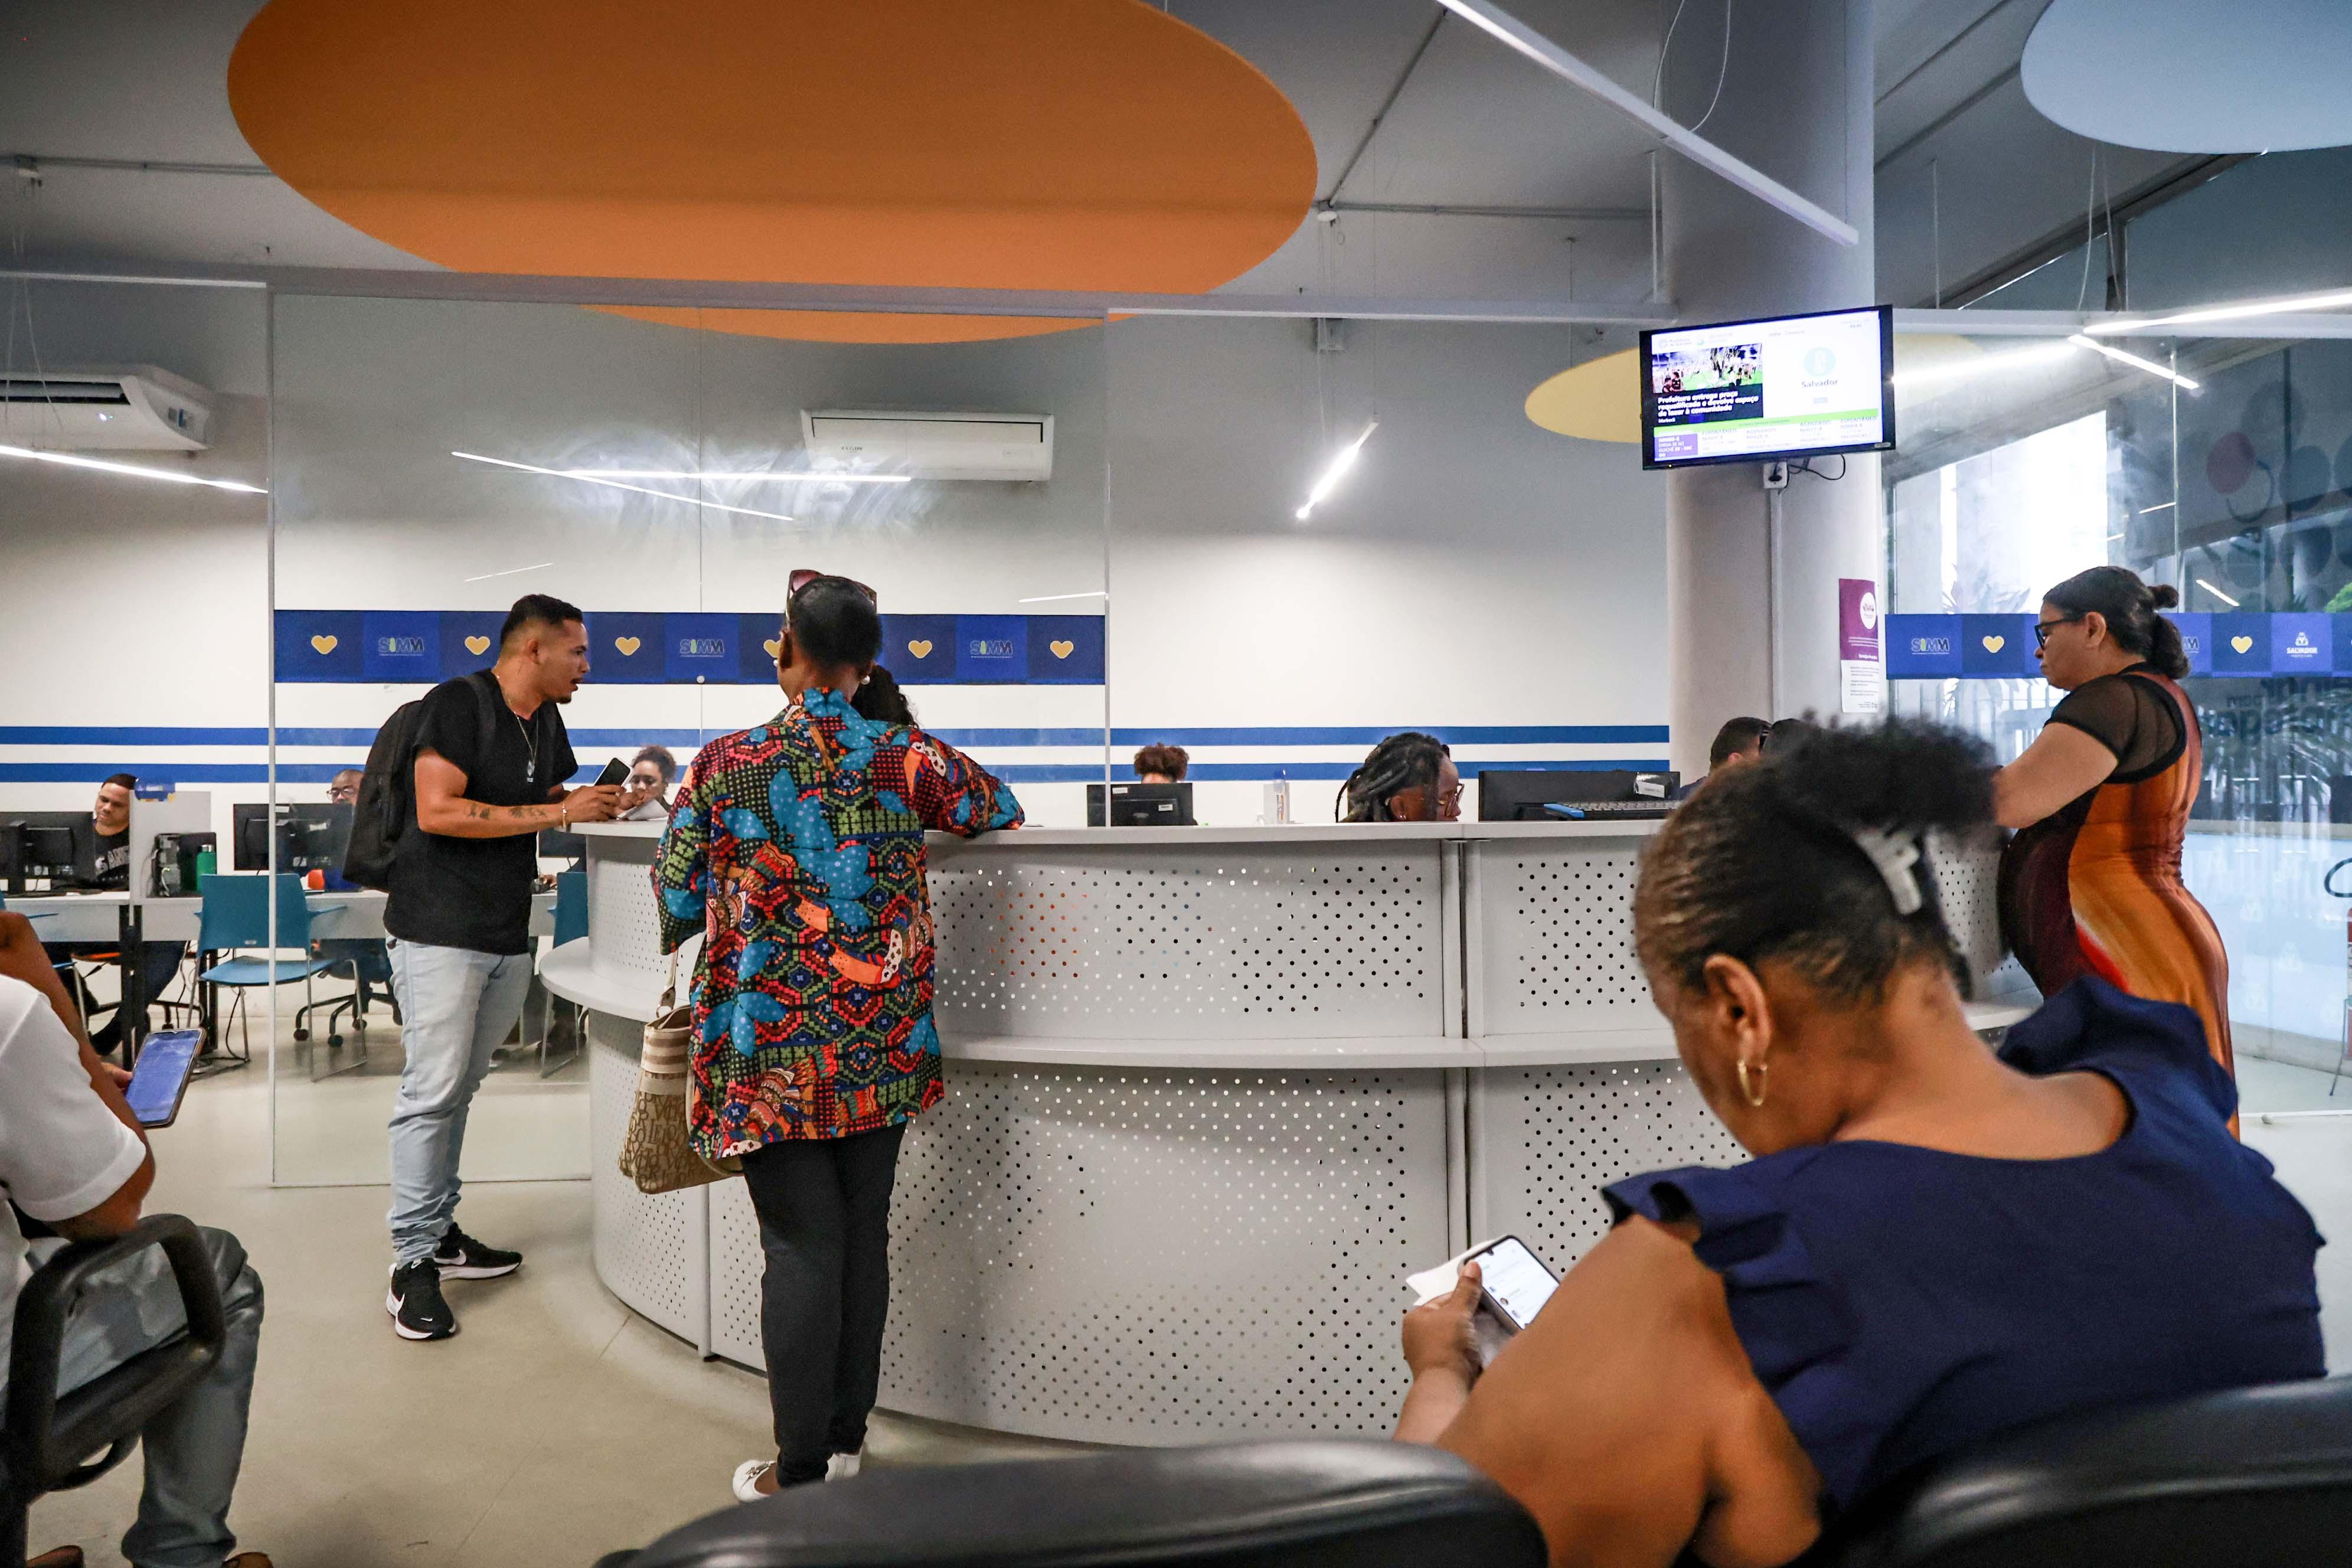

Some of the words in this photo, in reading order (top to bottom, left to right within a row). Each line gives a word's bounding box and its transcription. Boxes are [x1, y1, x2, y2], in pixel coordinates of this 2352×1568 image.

[1801, 379, 1838, 388] Salvador
[1658, 395, 1691, 404] Prefeitura
[1692, 393, 1717, 401] entrega
[1719, 391, 1738, 400] praça
[1658, 401, 1701, 411] requalificada
[1707, 397, 1733, 406] devolve
[1735, 396, 1759, 404] espaço
[1691, 405, 1733, 414] comunidade
[378, 637, 424, 653] SIMM
[680, 639, 724, 654] SIMM
[970, 640, 1013, 655] SIMM
[1911, 638, 1950, 652] SIMM
